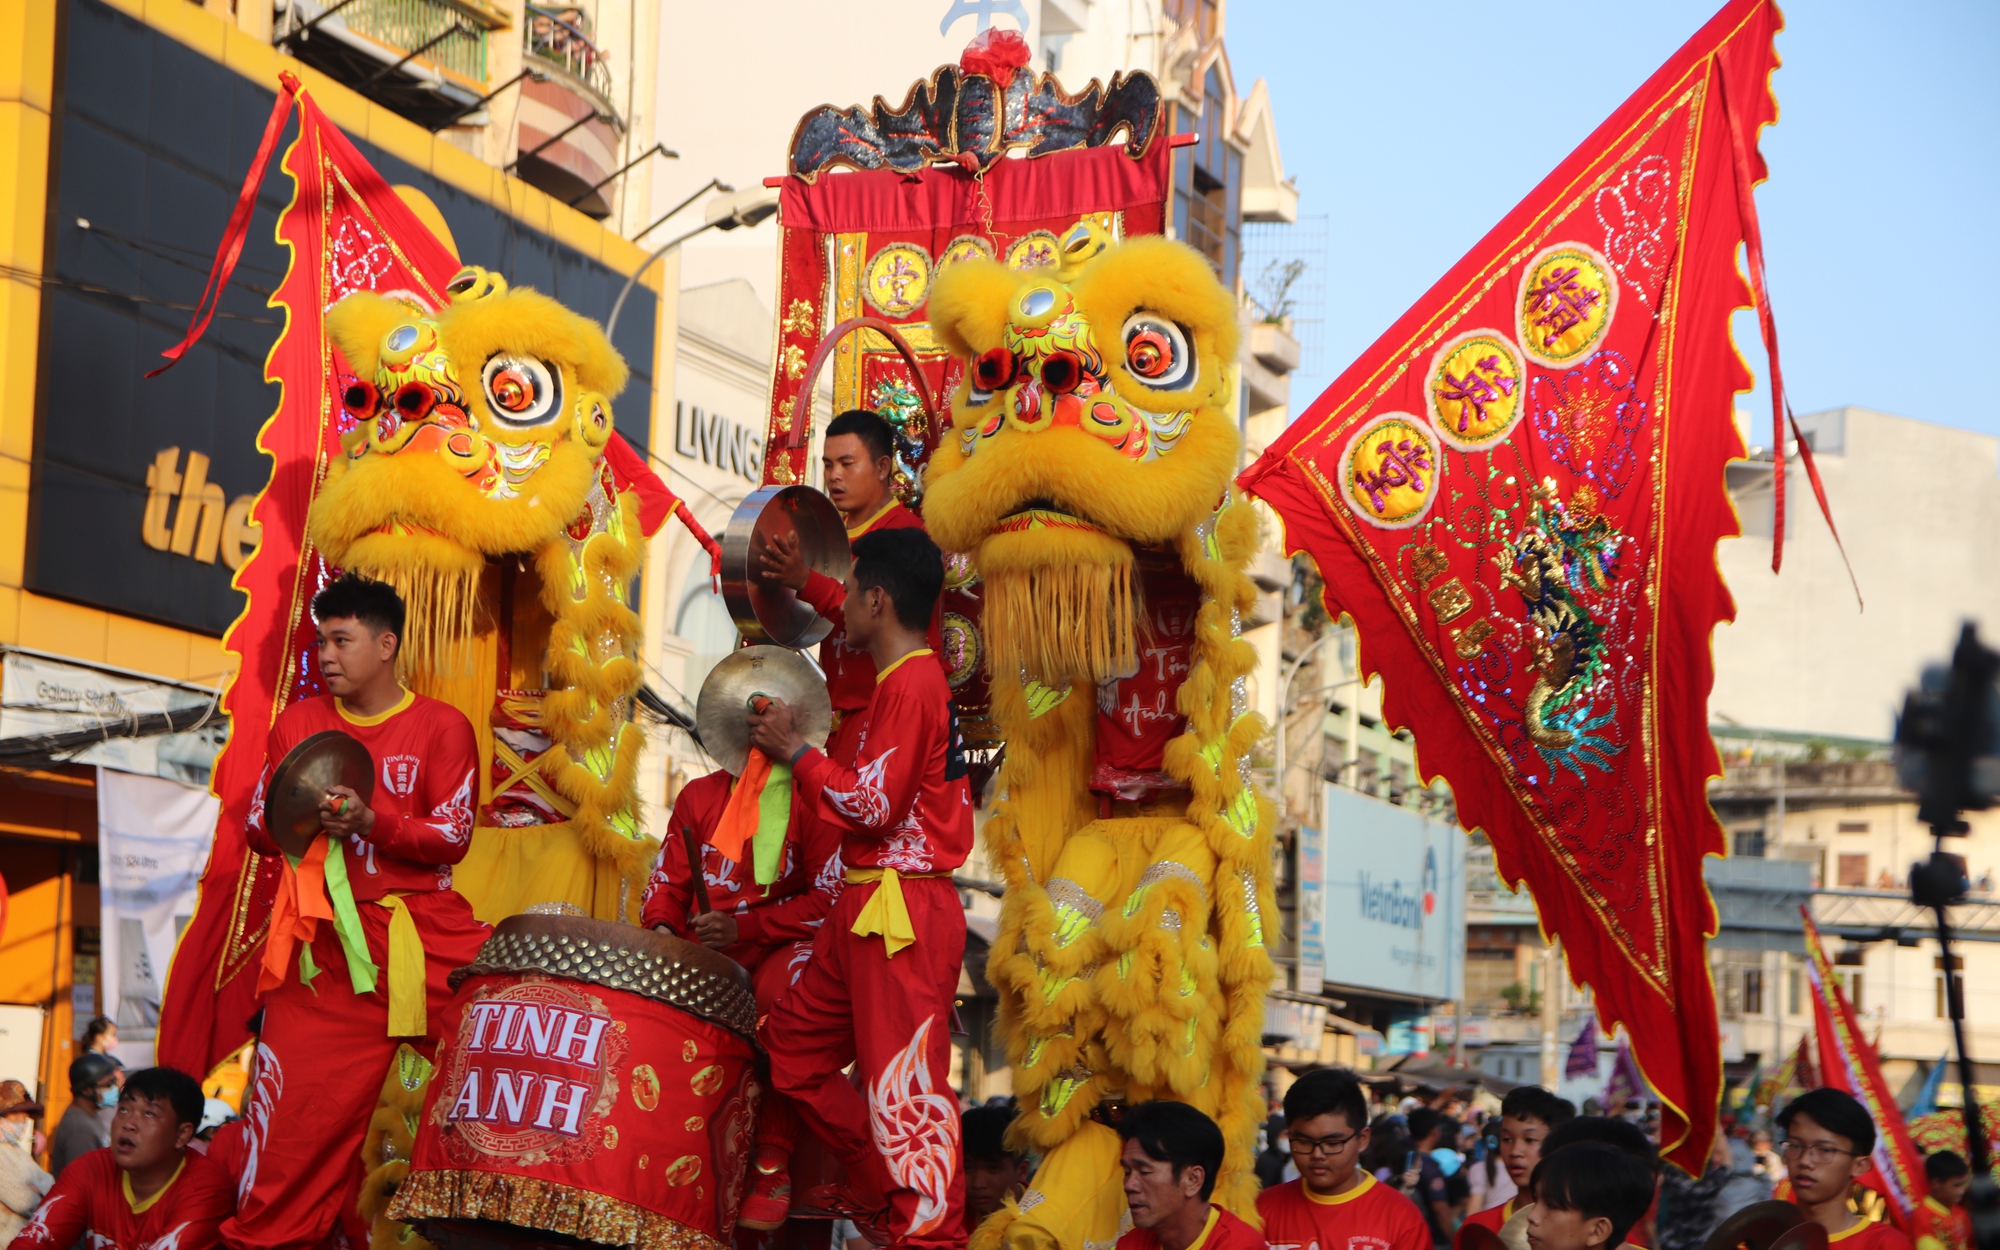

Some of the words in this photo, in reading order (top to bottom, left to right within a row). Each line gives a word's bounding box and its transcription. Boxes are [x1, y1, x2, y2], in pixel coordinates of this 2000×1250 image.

[675, 400, 761, 484] LIVING
[142, 446, 262, 573] the
[36, 680, 82, 711] Galaxy
[467, 1001, 613, 1070] TINH
[448, 1067, 593, 1139] ANH
